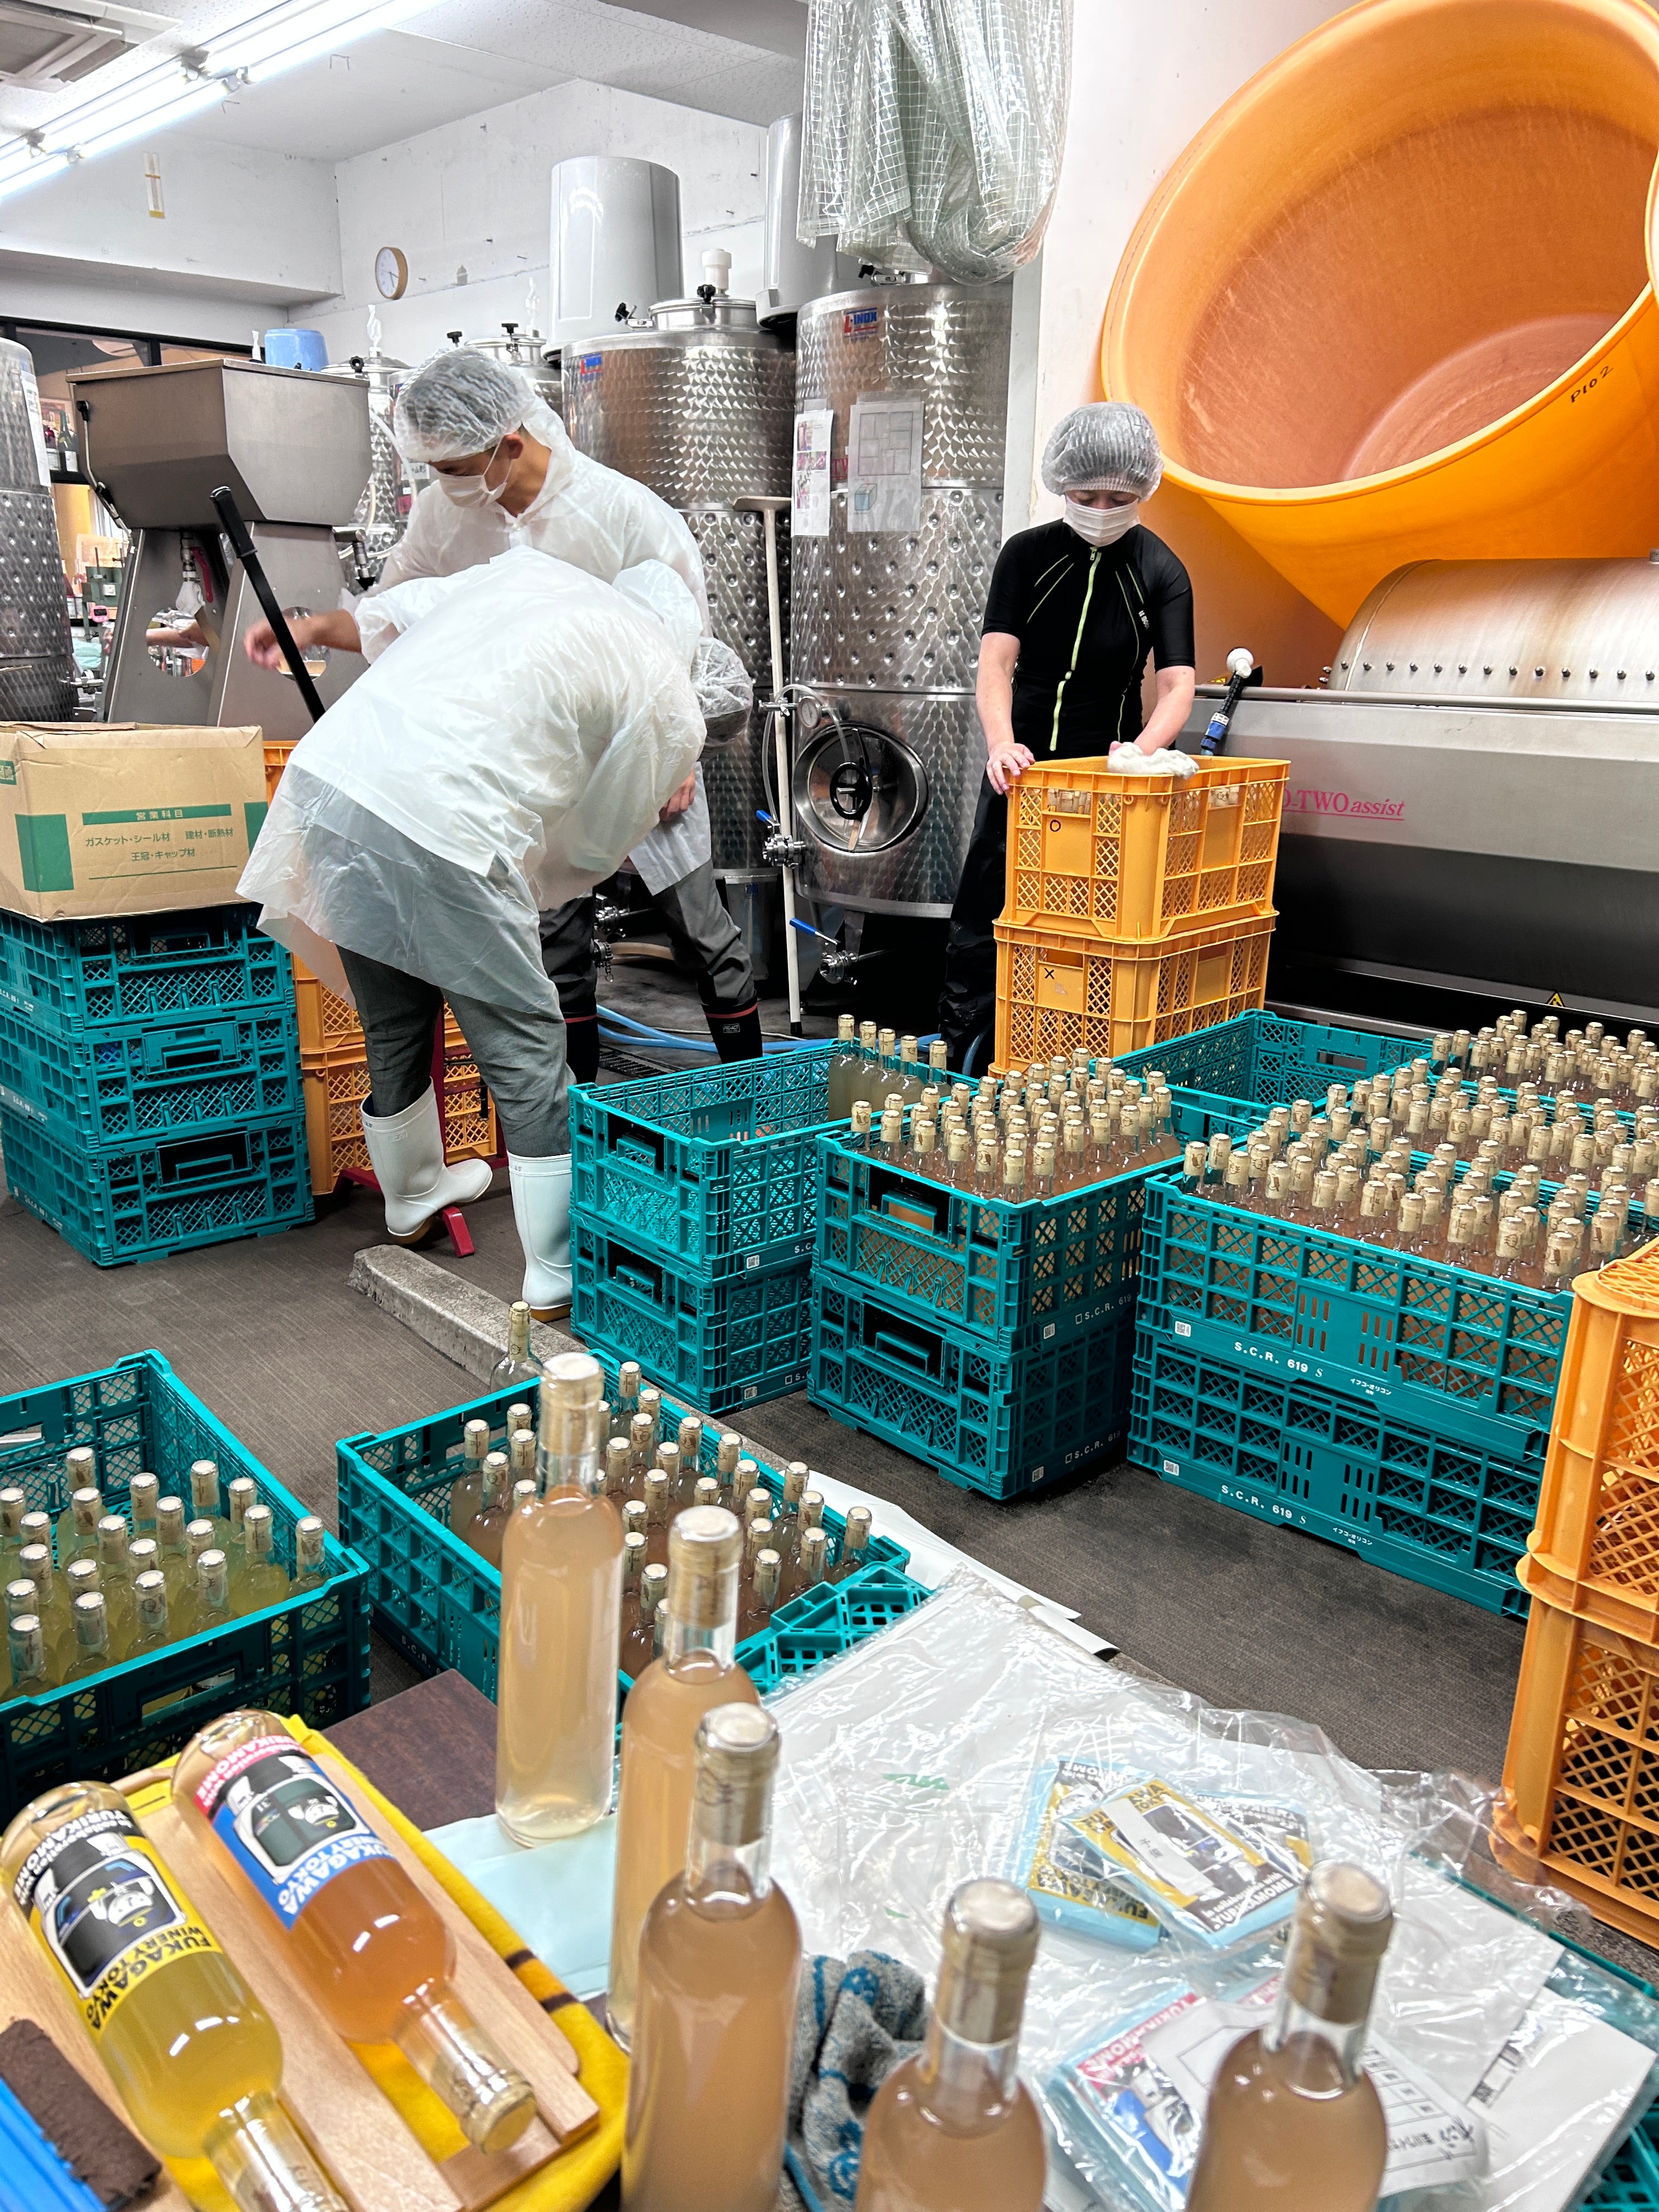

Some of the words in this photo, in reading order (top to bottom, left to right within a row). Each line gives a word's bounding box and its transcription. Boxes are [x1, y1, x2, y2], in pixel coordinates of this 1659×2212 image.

[136, 809, 183, 821] 営業科目
[1350, 799, 1404, 816] assist
[1085, 1302, 1114, 1320] S.C.R.
[1119, 1294, 1131, 1305] 619
[1234, 1341, 1279, 1364] S.C.R.
[1287, 1358, 1308, 1373] 619
[1315, 1368, 1323, 1378] S
[1075, 1441, 1103, 1459] S.C.R.
[1221, 1485, 1265, 1509] S.C.R.
[1272, 1505, 1293, 1519] 619
[1299, 1515, 1307, 1525] S
[14, 1809, 132, 1897] YURIKAMOME
[278, 1850, 330, 1906] TOKYO
[135, 1926, 205, 1959] WINERY
[86, 1957, 132, 2019] TOKYO
[91, 1935, 212, 2030] FUKAGAWA
